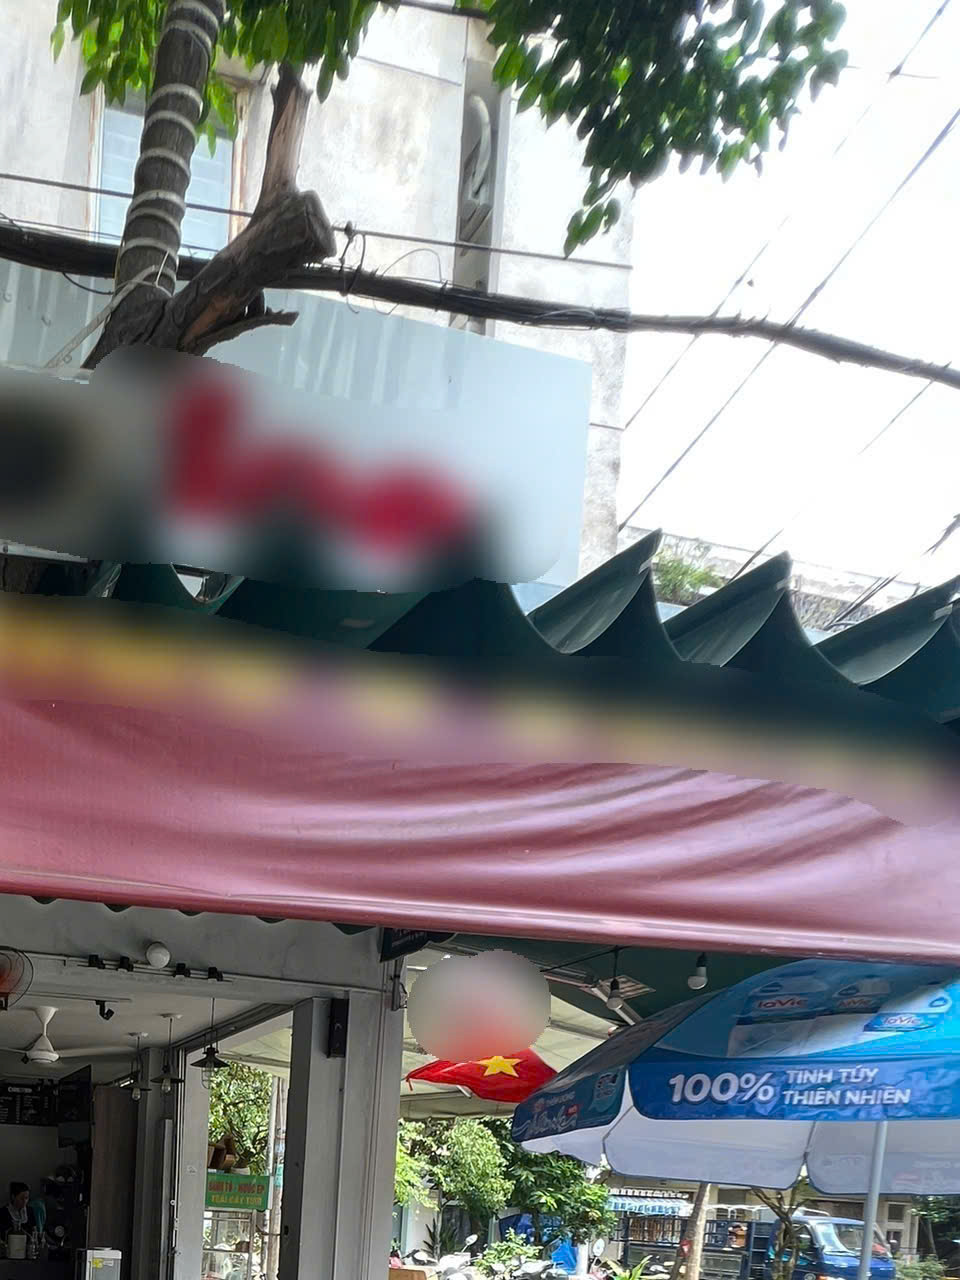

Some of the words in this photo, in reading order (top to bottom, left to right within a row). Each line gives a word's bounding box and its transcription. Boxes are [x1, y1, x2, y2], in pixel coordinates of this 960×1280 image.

[786, 1069, 833, 1084] TINH
[839, 1065, 878, 1083] TÚY
[669, 1072, 774, 1103] 100%
[783, 1087, 840, 1105] THIÊN
[844, 1086, 910, 1104] NHIÊN
